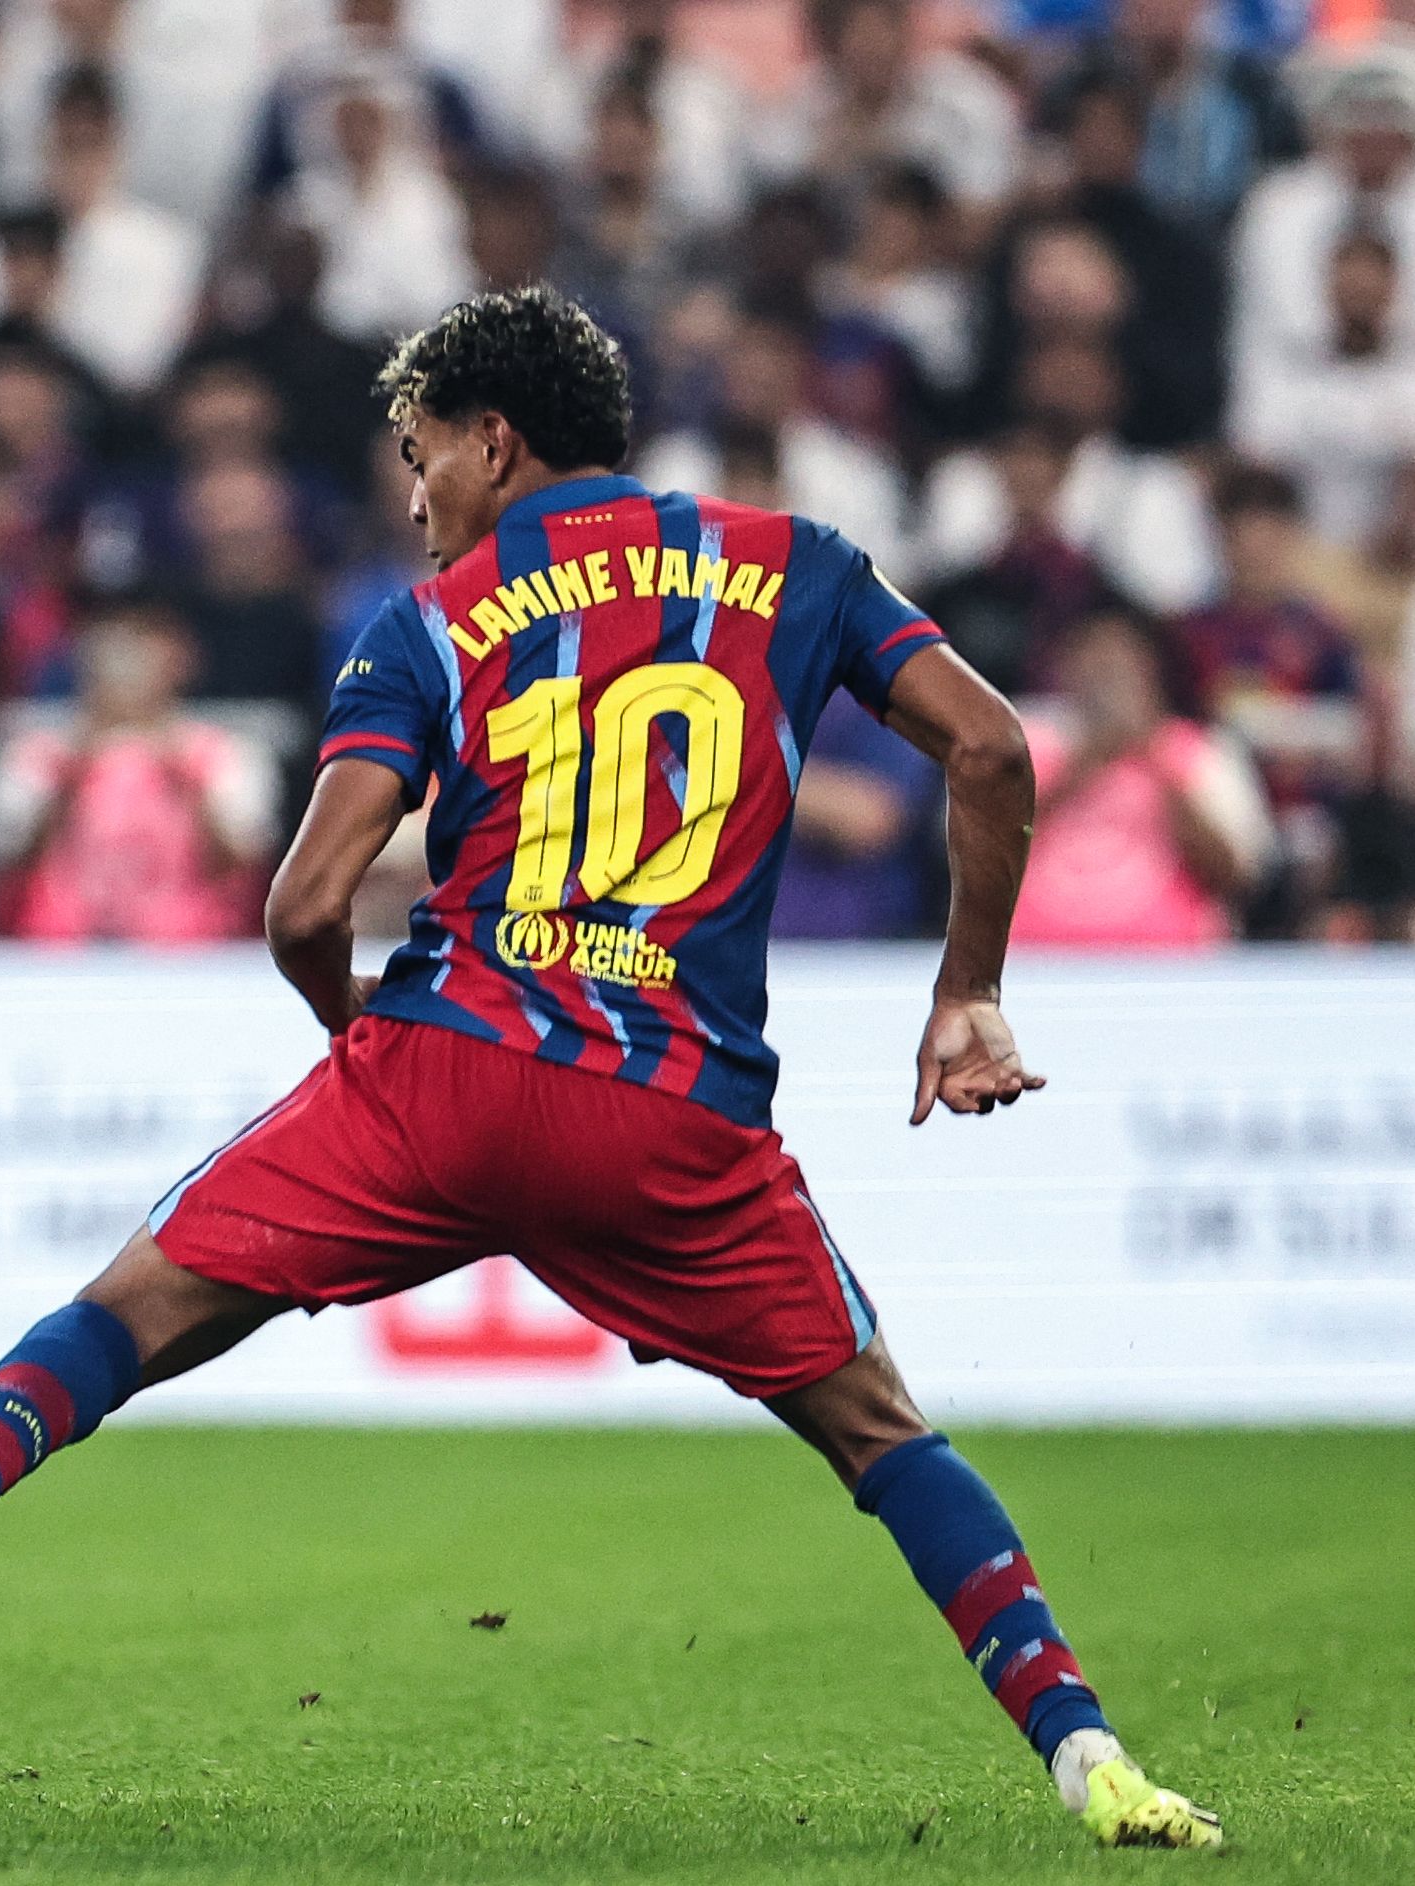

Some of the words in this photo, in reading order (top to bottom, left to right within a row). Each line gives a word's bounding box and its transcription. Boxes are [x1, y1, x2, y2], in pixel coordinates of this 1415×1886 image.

[447, 549, 618, 662] LAMINE
[624, 545, 784, 620] YAMAL
[486, 660, 745, 912] 10
[569, 943, 678, 982] ACNUR
